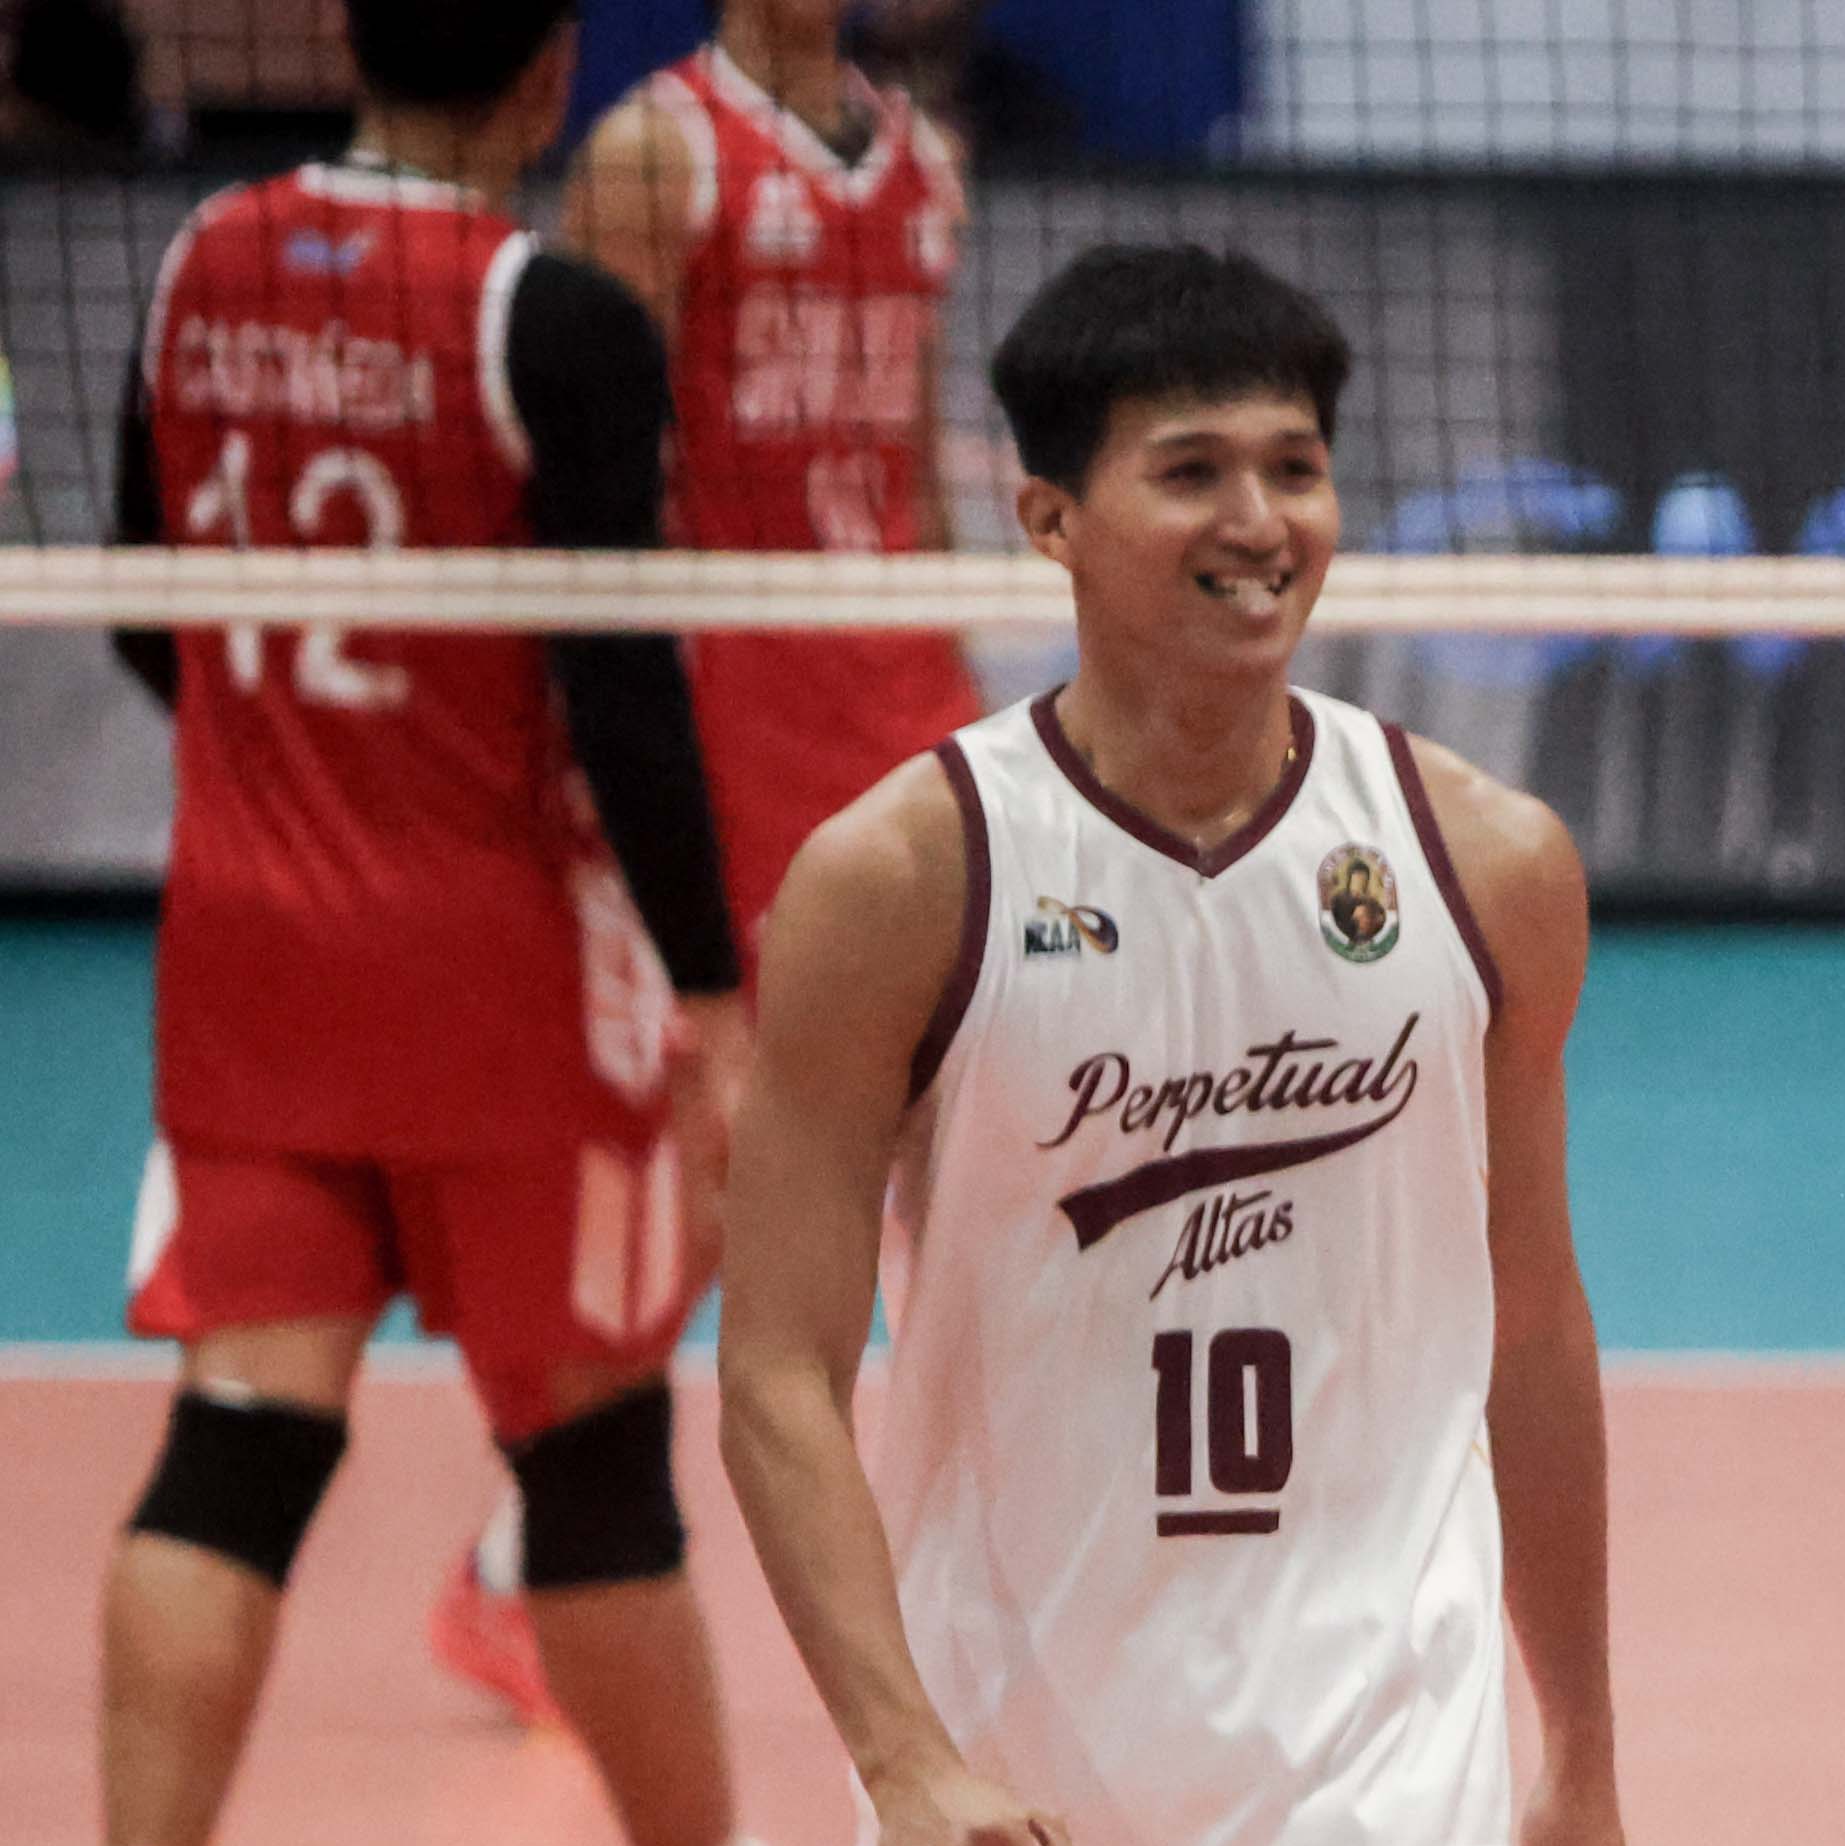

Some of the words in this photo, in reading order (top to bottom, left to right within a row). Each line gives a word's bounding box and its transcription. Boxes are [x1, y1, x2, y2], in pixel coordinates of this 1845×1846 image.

[188, 431, 409, 709] 12
[1036, 1013, 1420, 1151] Perpetual
[1150, 1190, 1294, 1301] Altas
[1152, 1328, 1293, 1496] 10
